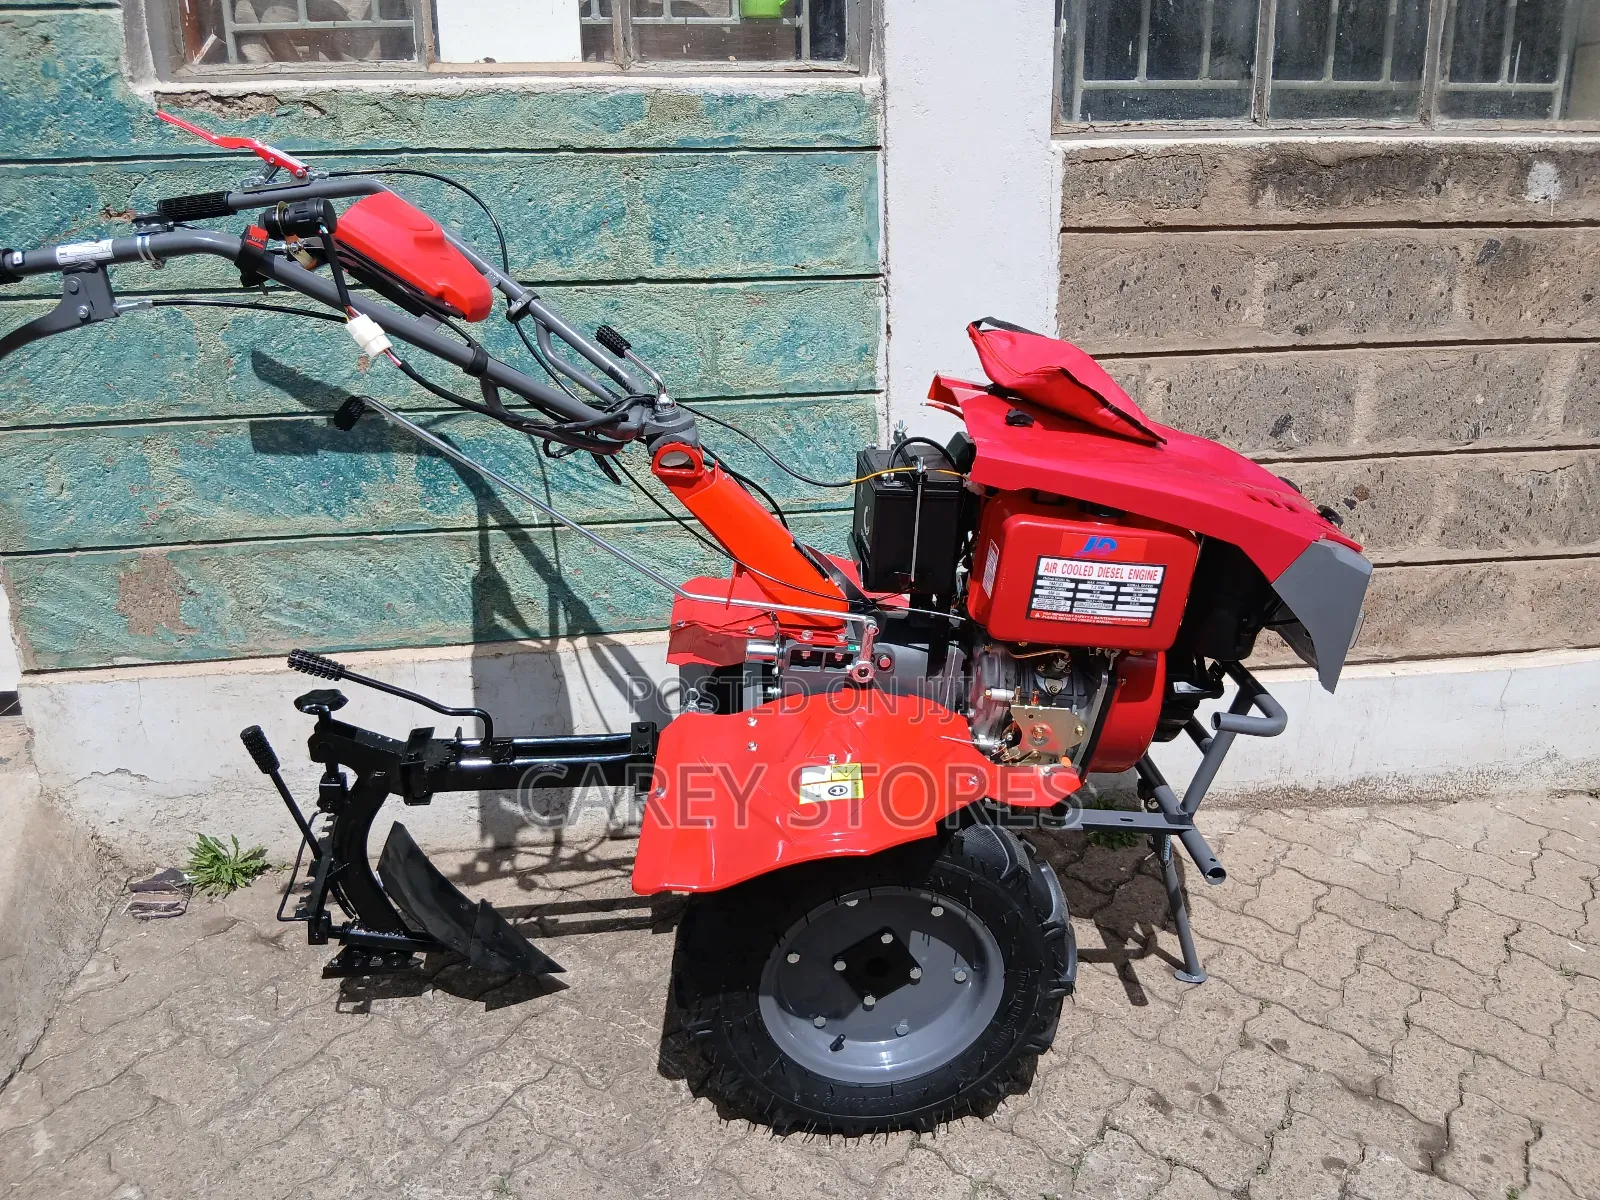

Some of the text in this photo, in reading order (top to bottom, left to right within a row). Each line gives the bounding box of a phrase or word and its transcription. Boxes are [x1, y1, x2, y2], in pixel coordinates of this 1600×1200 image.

[251, 235, 262, 243] OFF
[1043, 562, 1159, 581] AIR COOLED DIESEL ENGINE
